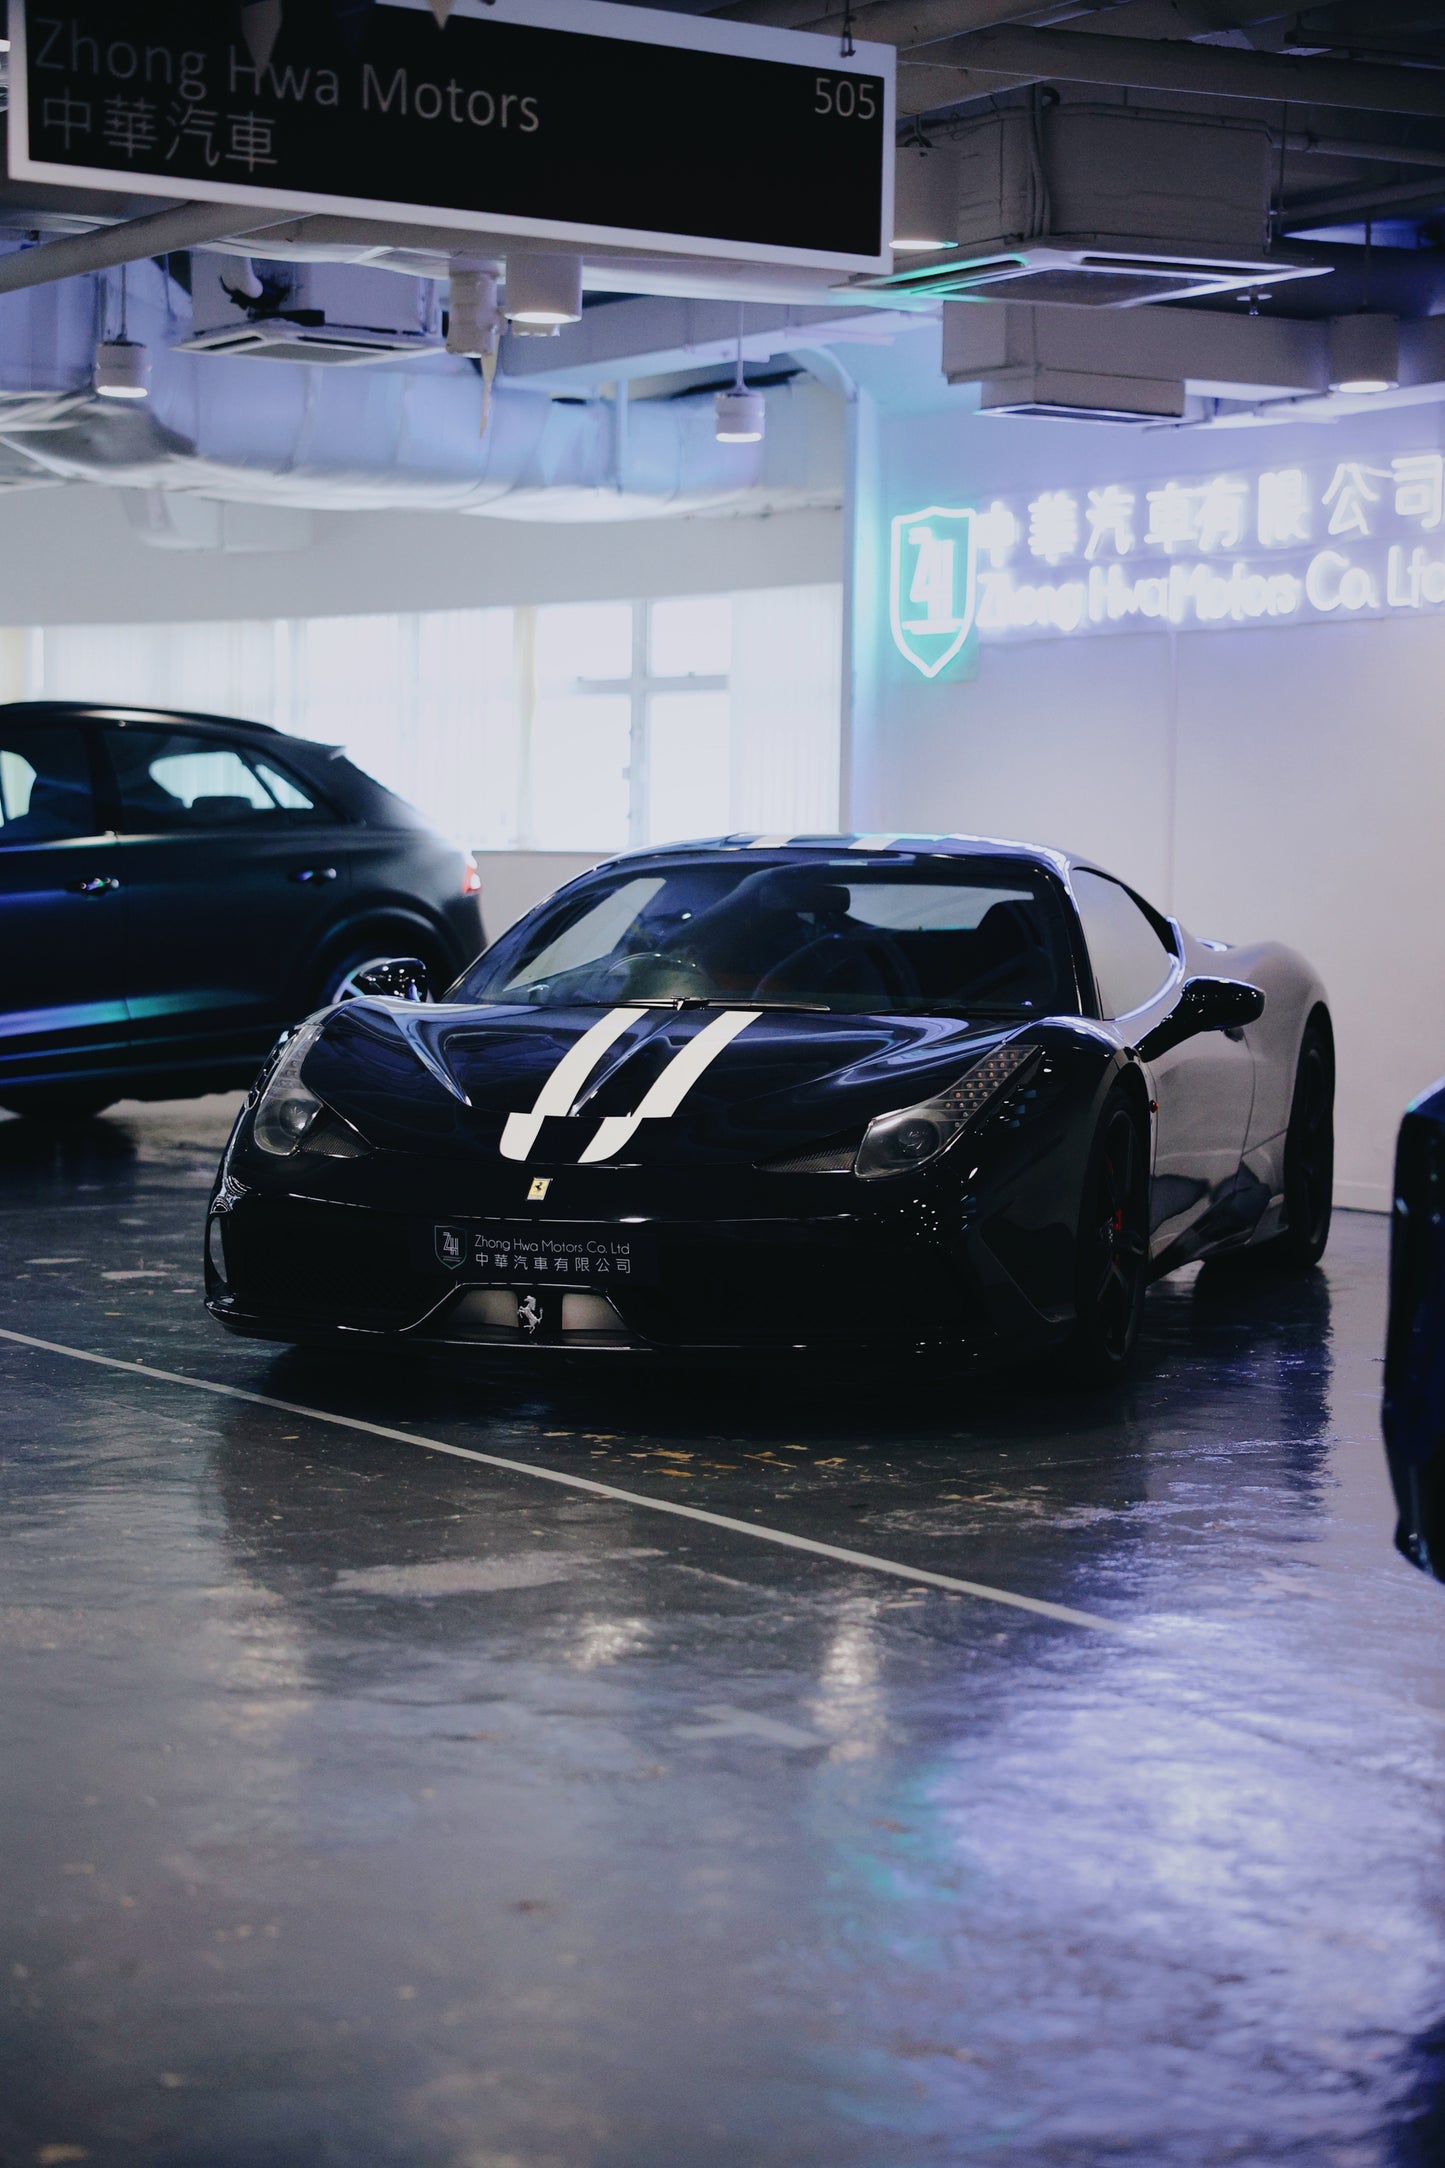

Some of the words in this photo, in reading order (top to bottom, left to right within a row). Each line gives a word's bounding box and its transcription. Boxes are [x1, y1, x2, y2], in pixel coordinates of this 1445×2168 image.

[35, 17, 207, 101] Zhong
[229, 44, 339, 106] Hwa
[362, 63, 540, 132] Motors
[814, 77, 876, 120] 505
[43, 87, 279, 173] 中華汽車
[475, 1234, 511, 1252] Zhong
[513, 1238, 539, 1252] Hwa
[541, 1240, 583, 1254] Motors
[586, 1241, 608, 1254] Co.
[610, 1242, 630, 1255] Ltd
[475, 1252, 631, 1274] 中華汽車有限公司
